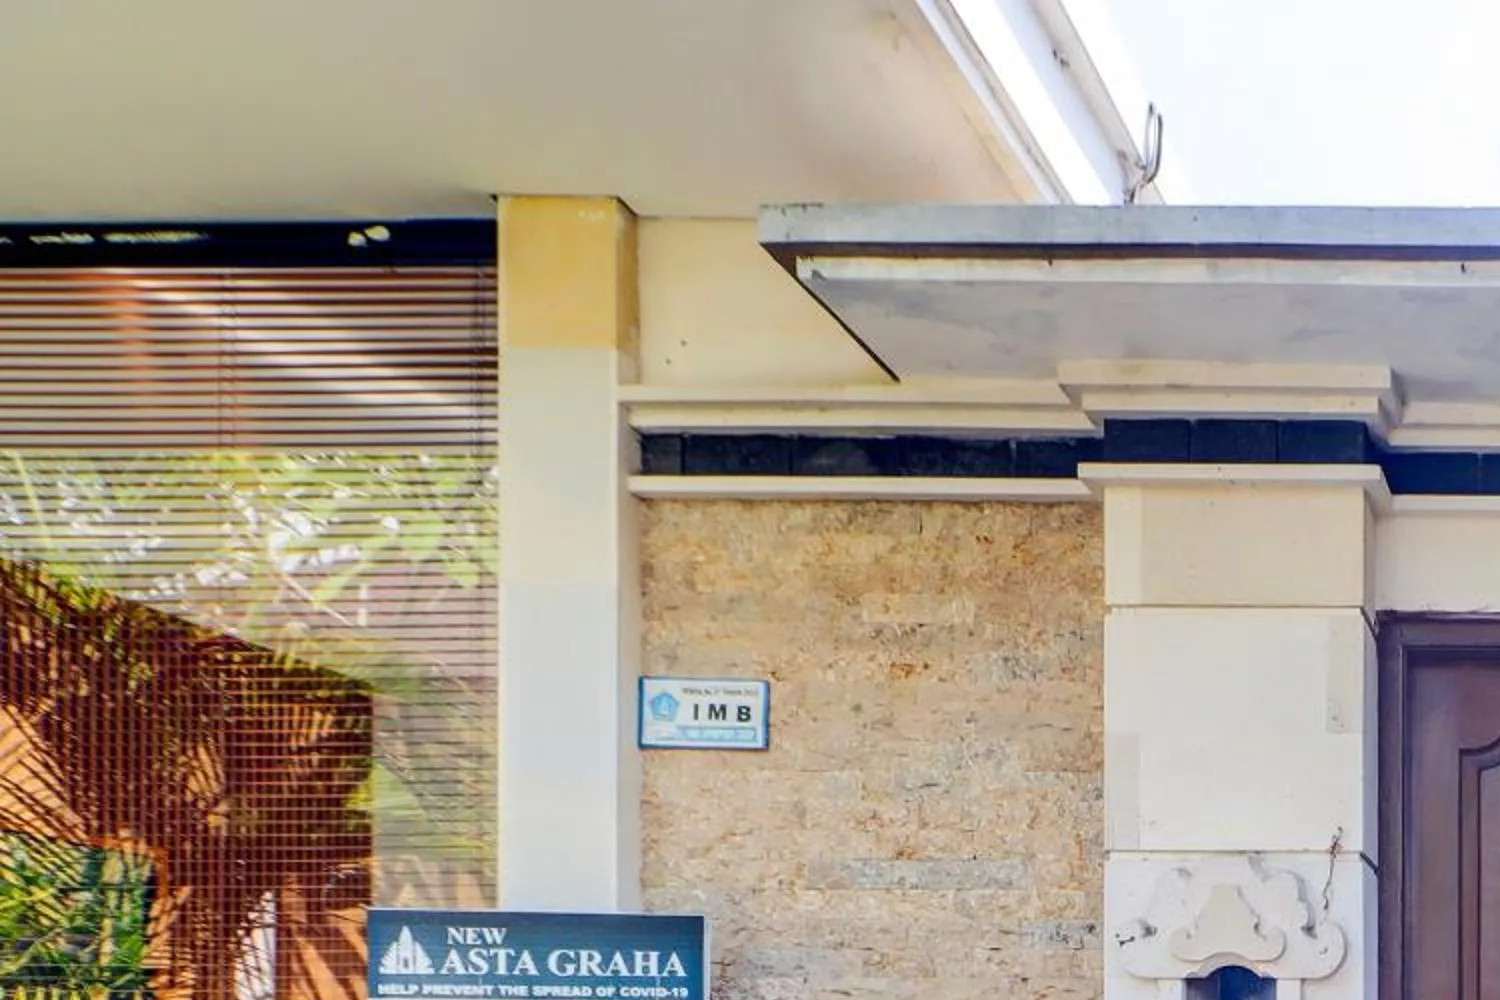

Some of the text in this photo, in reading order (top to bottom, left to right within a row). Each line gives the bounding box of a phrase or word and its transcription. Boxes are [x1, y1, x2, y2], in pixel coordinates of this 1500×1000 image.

[446, 927, 507, 945] NEW
[439, 948, 688, 977] ASTA GRAHA
[377, 983, 689, 998] HELP PREVENT THE SPREAD OF COVID-19
